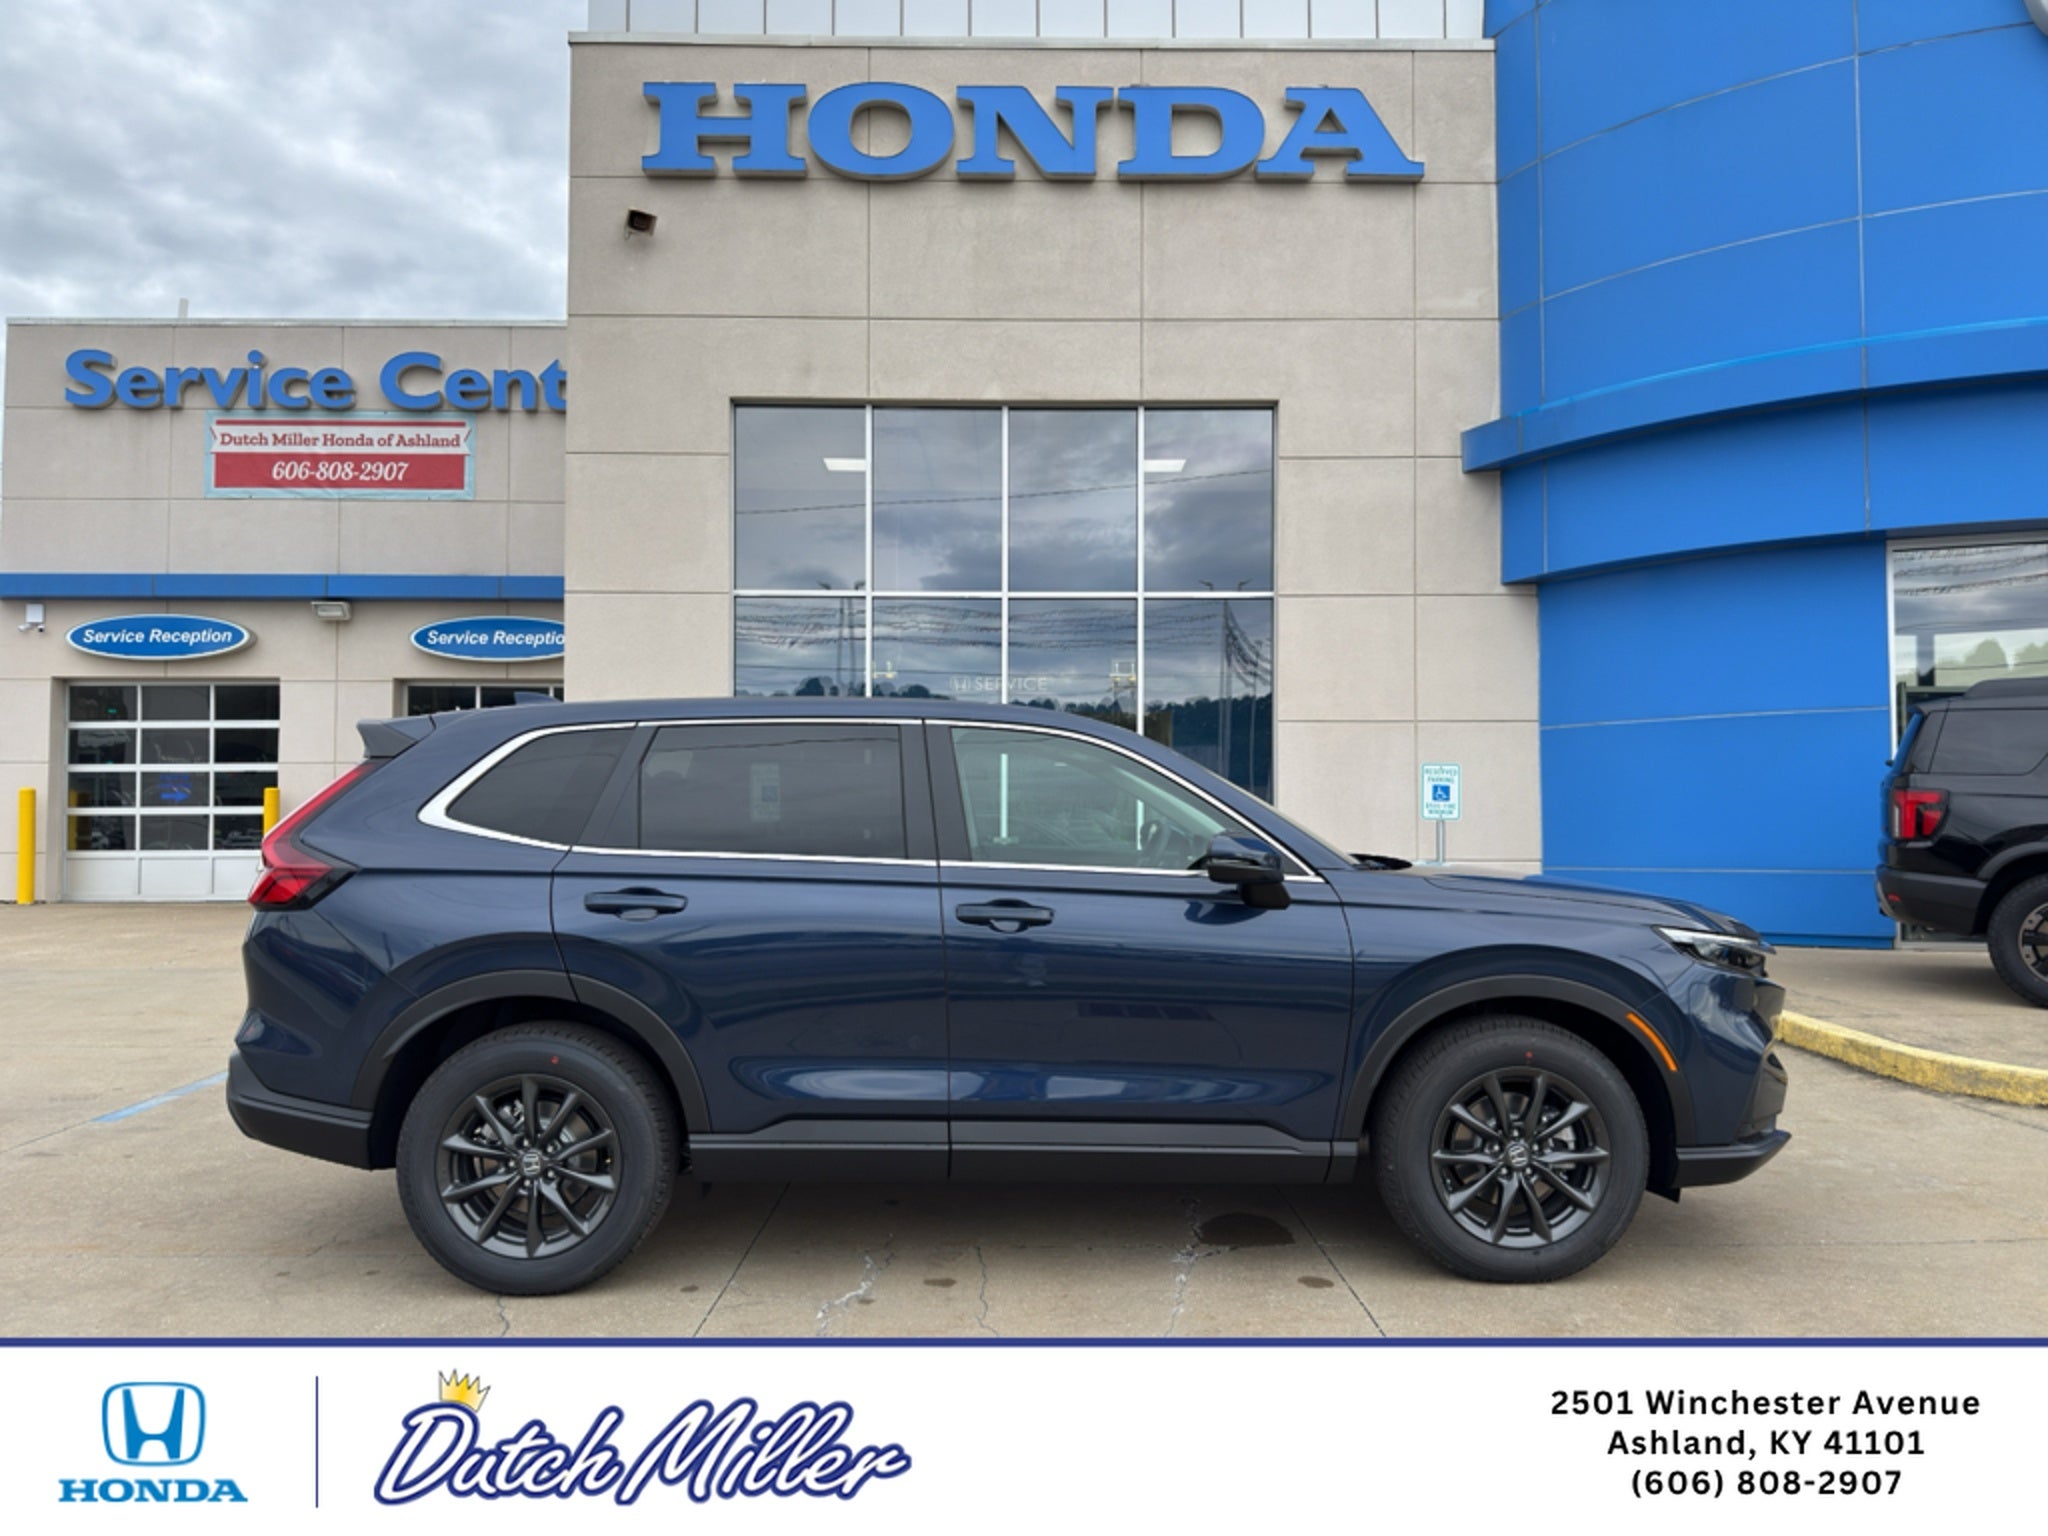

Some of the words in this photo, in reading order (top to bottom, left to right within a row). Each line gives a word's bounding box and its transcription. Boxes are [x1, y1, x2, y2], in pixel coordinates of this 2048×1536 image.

[642, 82, 1424, 181] HONDA
[65, 349, 354, 409] Service
[220, 432, 269, 447] Dutch
[272, 432, 320, 447] Miller
[321, 433, 375, 448] Honda
[376, 433, 396, 448] of
[395, 433, 461, 448] Ashland
[272, 460, 410, 481] 606-808-2907
[82, 629, 145, 643] Service
[149, 628, 233, 647] Reception
[427, 629, 489, 645] Service
